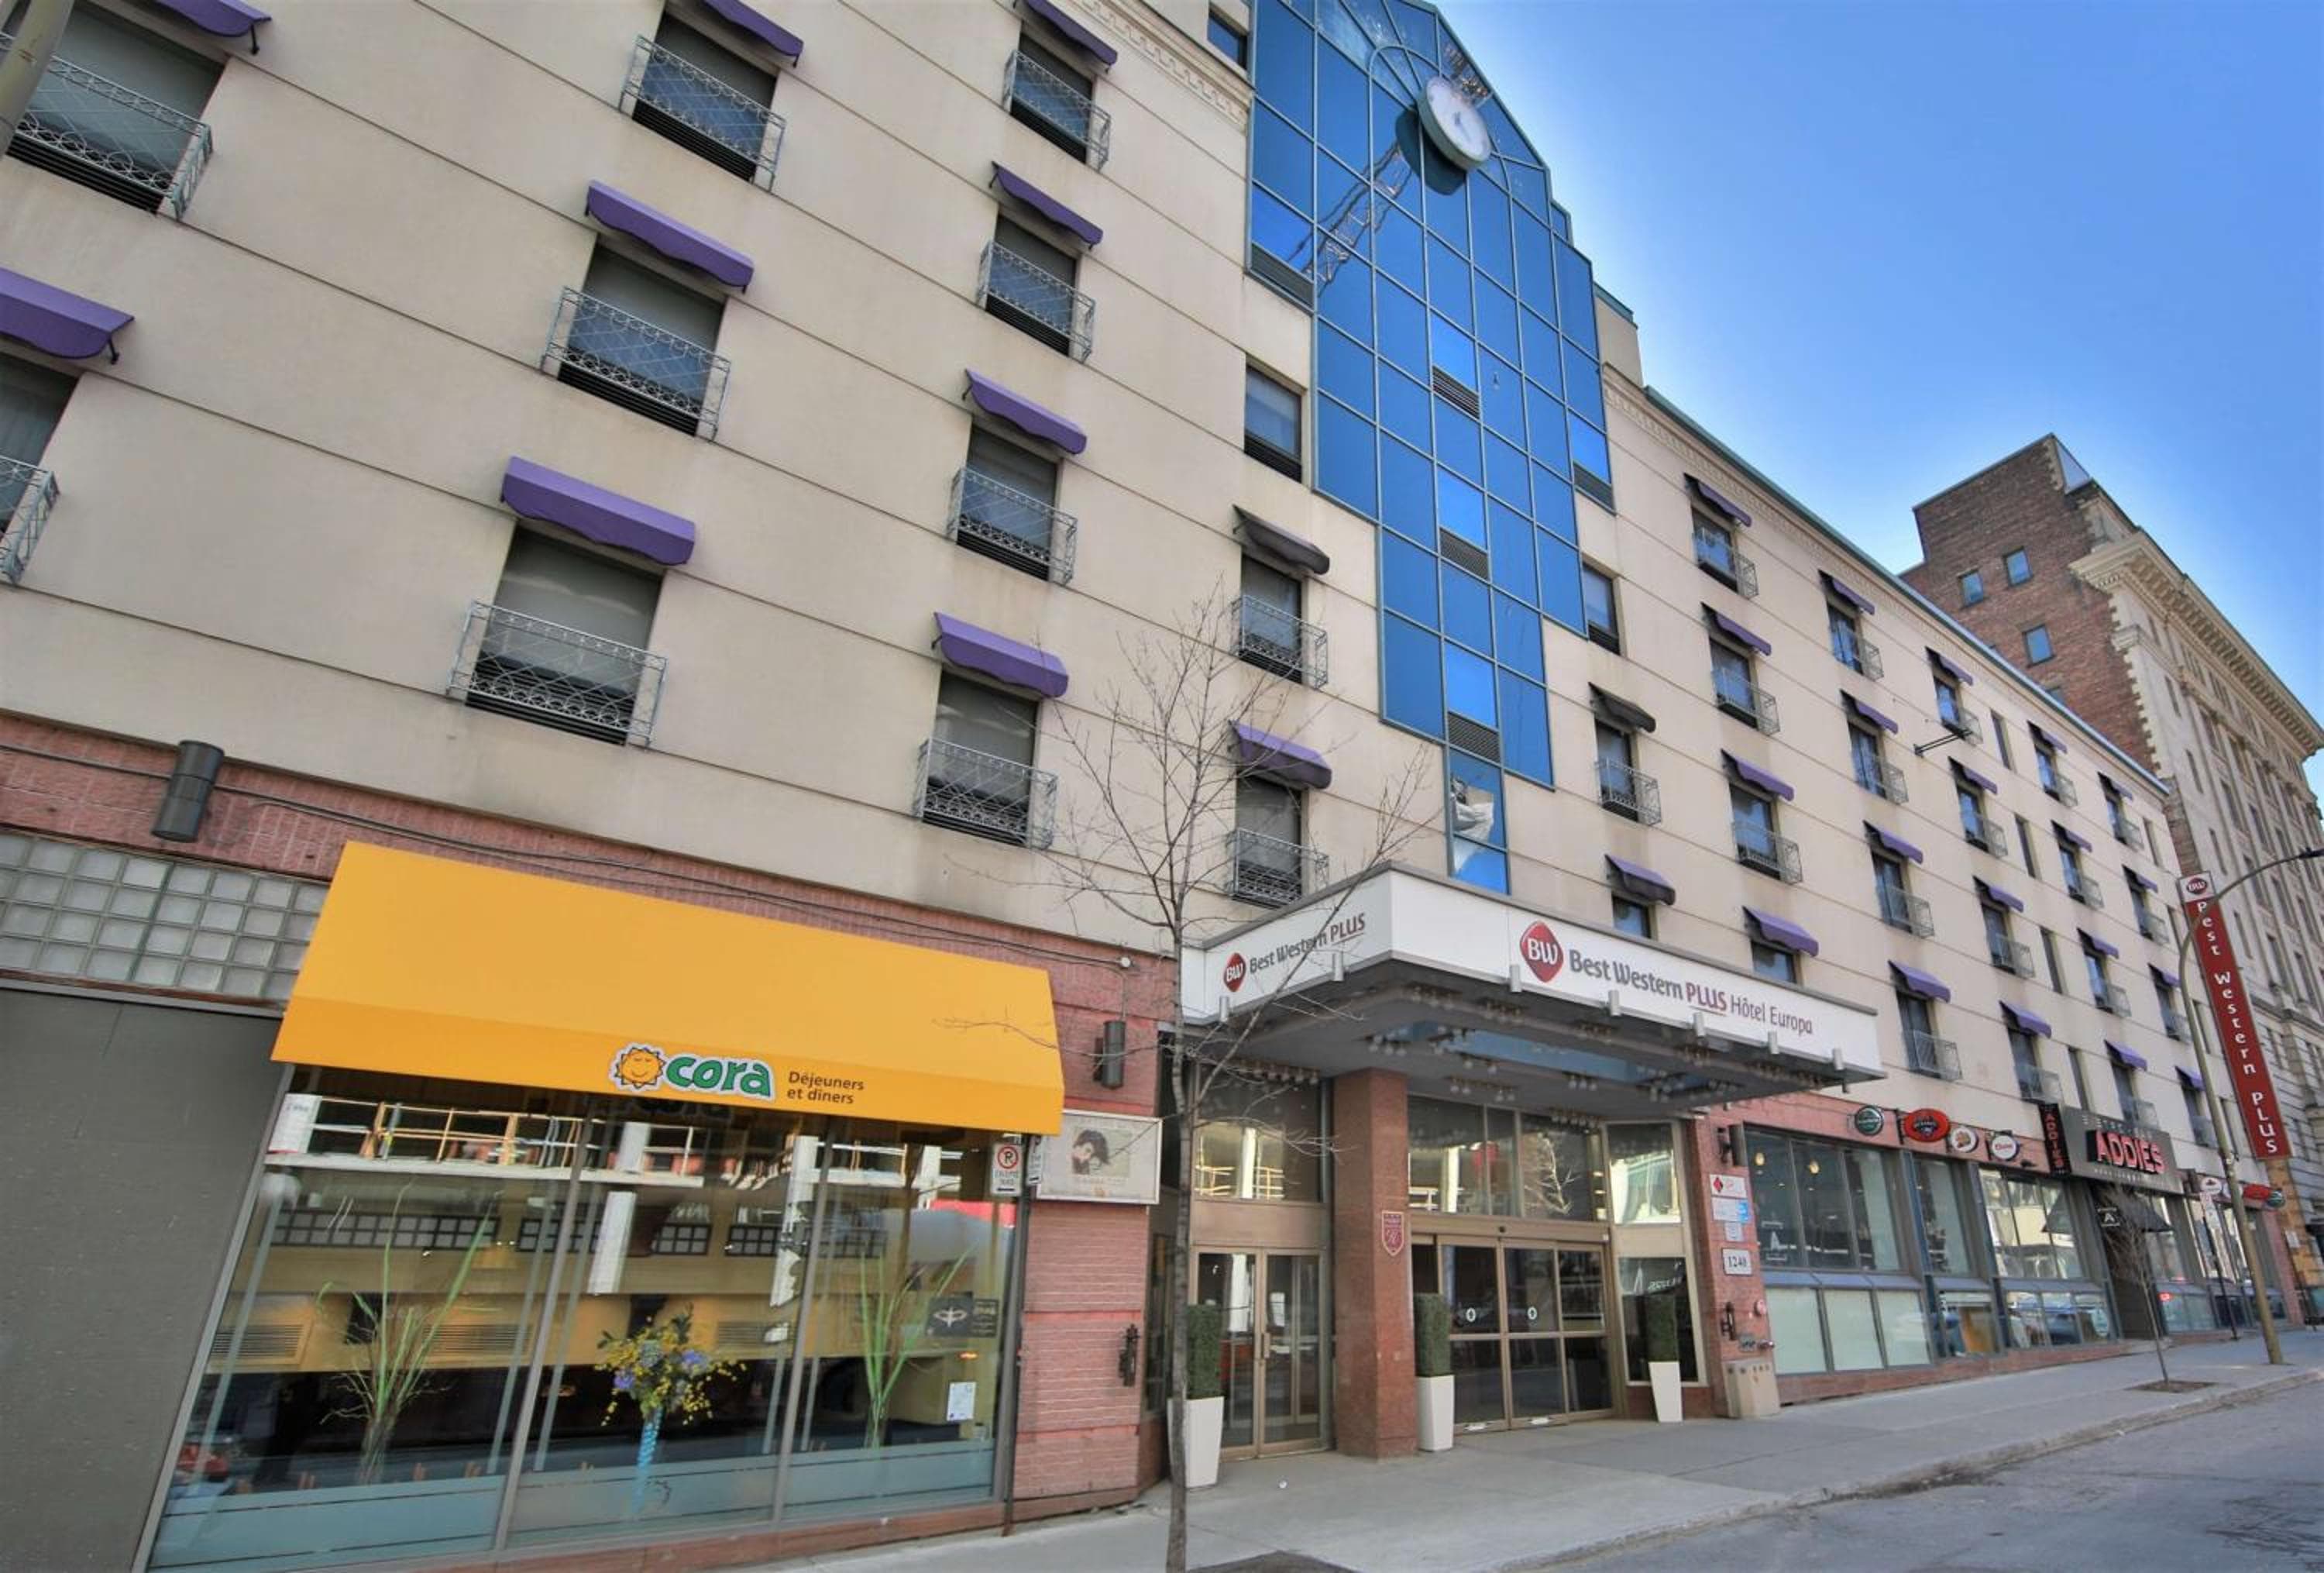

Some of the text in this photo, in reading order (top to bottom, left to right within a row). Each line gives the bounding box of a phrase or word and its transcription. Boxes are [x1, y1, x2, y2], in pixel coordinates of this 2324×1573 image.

[1250, 913, 1365, 973] Best Western PLUS
[1527, 938, 1558, 965] BW
[1226, 963, 1243, 981] BW
[1569, 949, 1813, 1035] Best Western PLUS Hôtel Europa
[665, 1056, 771, 1096] cora
[2214, 971, 2256, 1075] Western
[2251, 1092, 2278, 1153] PLUS
[787, 1089, 803, 1099] et
[2095, 1131, 2165, 1175] ADDIES
